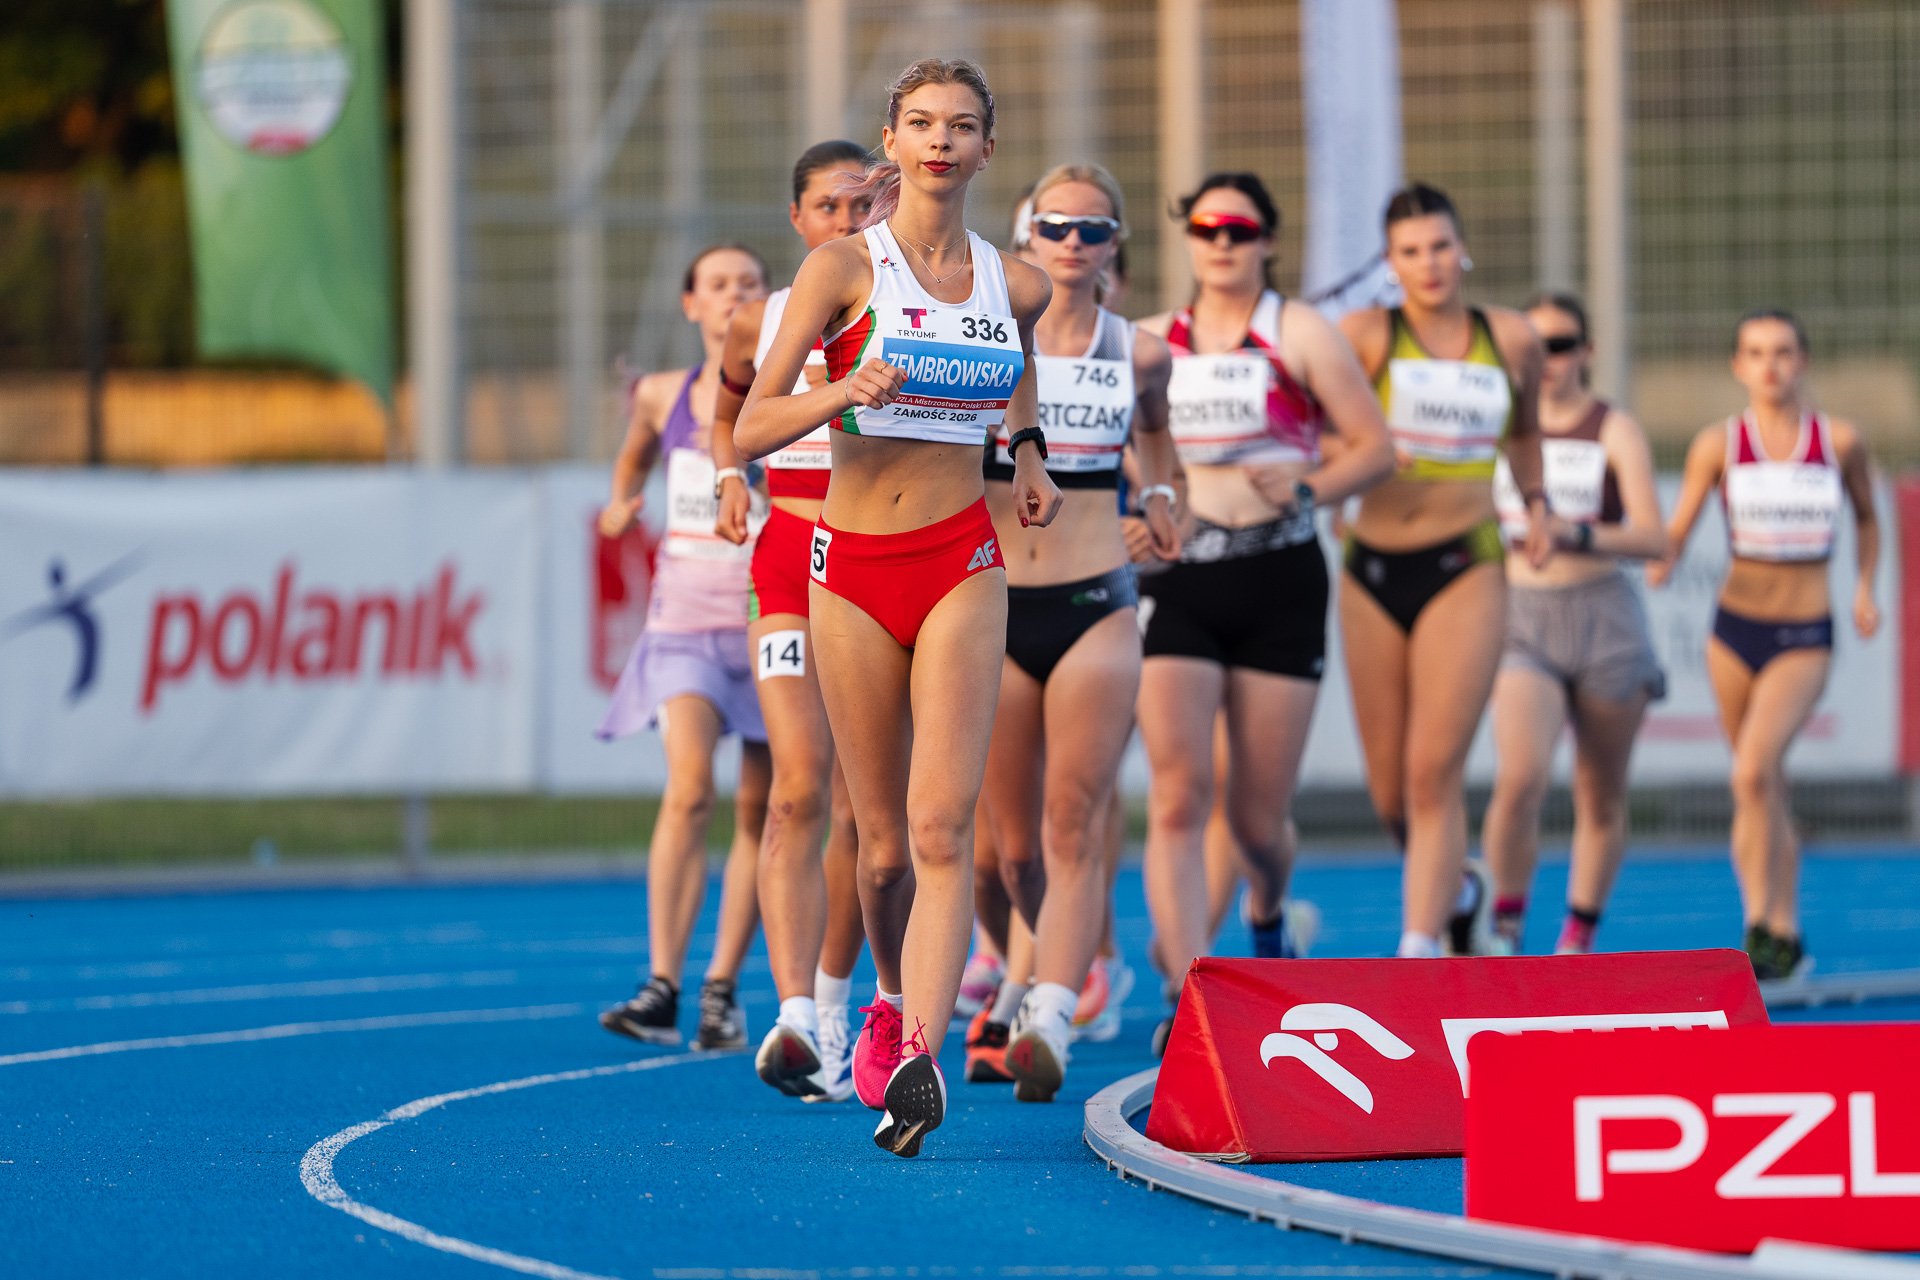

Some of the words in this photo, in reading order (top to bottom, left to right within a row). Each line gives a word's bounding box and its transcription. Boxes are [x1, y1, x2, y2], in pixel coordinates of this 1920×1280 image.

[897, 329, 937, 340] TRYUMF
[961, 316, 1008, 344] 336
[887, 352, 1014, 387] ZEMBROWSKA
[1073, 364, 1118, 387] 746
[893, 407, 947, 421] ZAMOŚĆ
[949, 412, 978, 422] 2026
[895, 395, 913, 404] PZLA
[915, 398, 960, 409] Mistrzostwa
[961, 402, 981, 410] Polski
[982, 401, 997, 409] U20
[1169, 399, 1260, 424] OSTEK
[1038, 403, 1127, 430] RTCZAK
[813, 536, 828, 573] 5
[140, 556, 486, 716] polanik
[760, 639, 802, 668] 14
[1573, 1091, 1920, 1202] PZL
